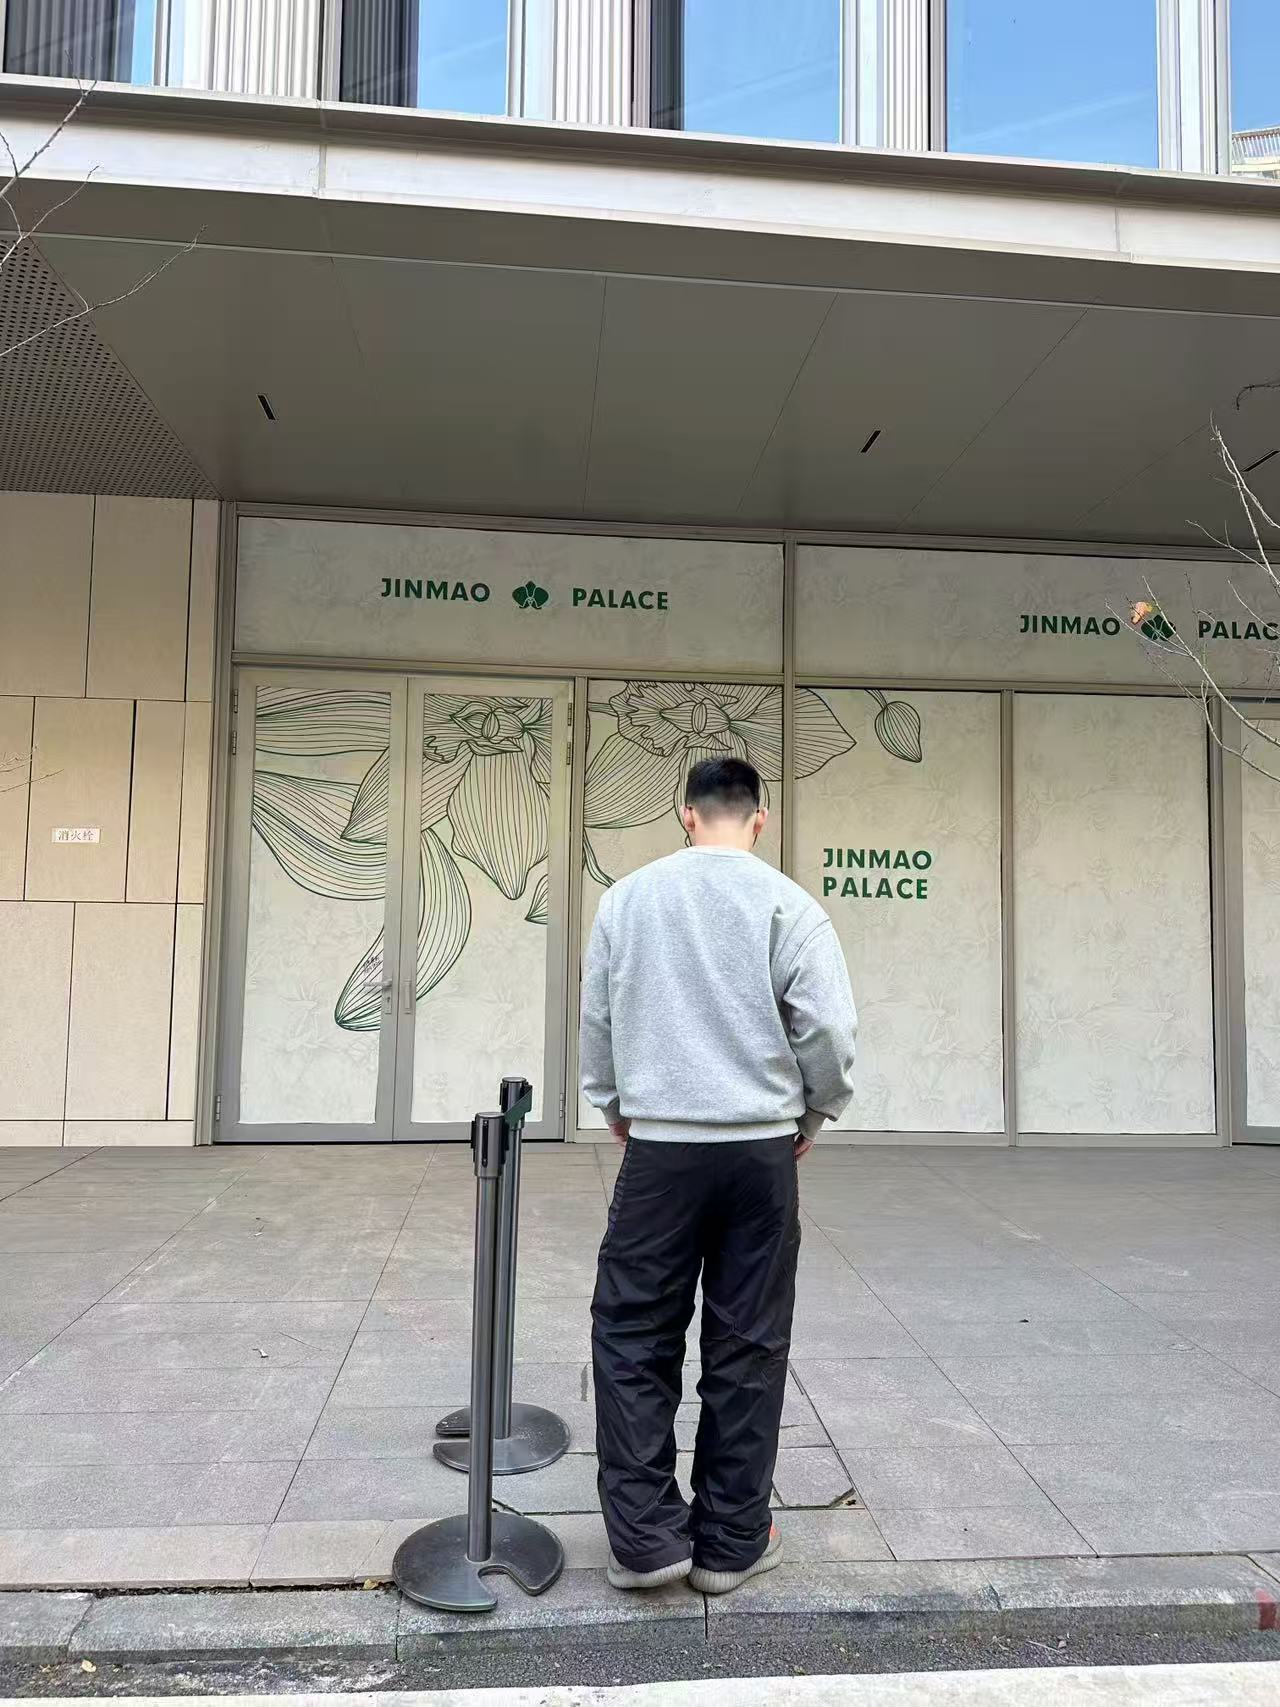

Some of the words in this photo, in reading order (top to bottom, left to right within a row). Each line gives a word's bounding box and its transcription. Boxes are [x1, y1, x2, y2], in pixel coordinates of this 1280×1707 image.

[380, 577, 491, 603] JINMAO
[572, 587, 669, 611] PALACE
[1019, 614, 1121, 636] JINMAO
[823, 848, 932, 870] JINMAO
[823, 876, 928, 900] PALACE
